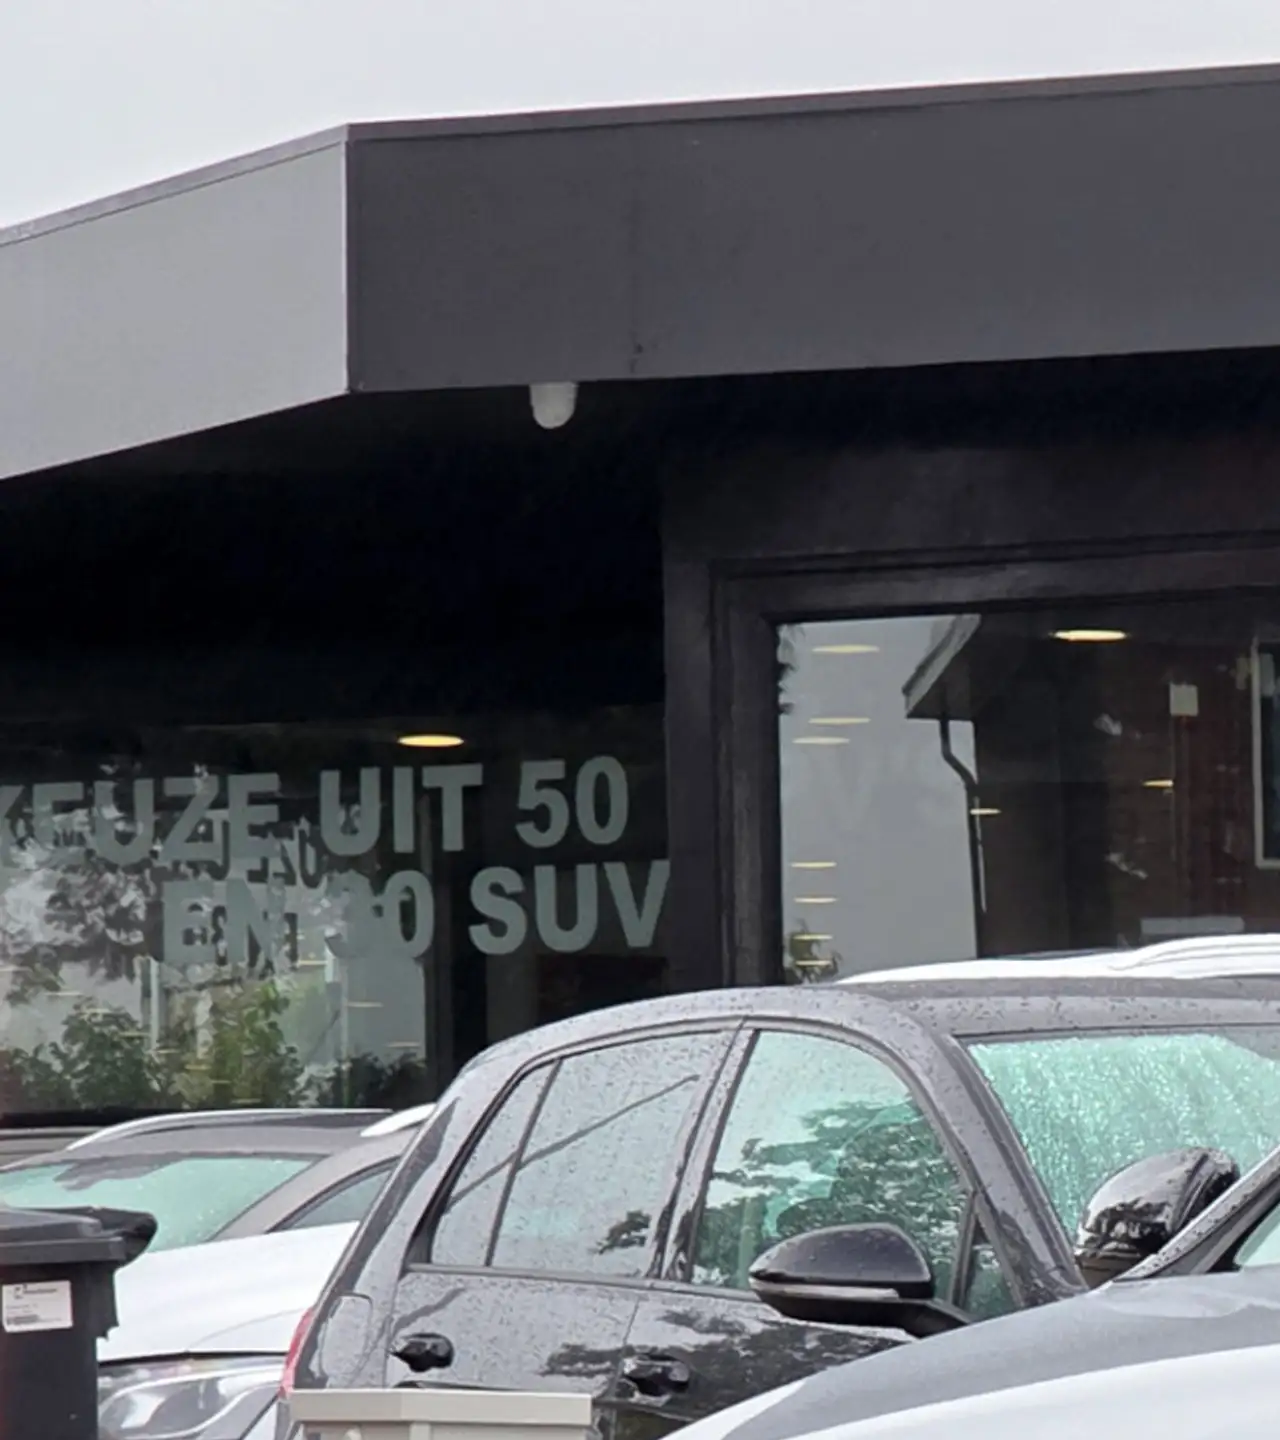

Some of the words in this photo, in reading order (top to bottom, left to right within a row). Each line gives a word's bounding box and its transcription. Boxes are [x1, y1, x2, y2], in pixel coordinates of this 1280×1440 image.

[320, 763, 483, 857] UIT
[516, 756, 629, 848] 50
[469, 860, 670, 956] SUV
